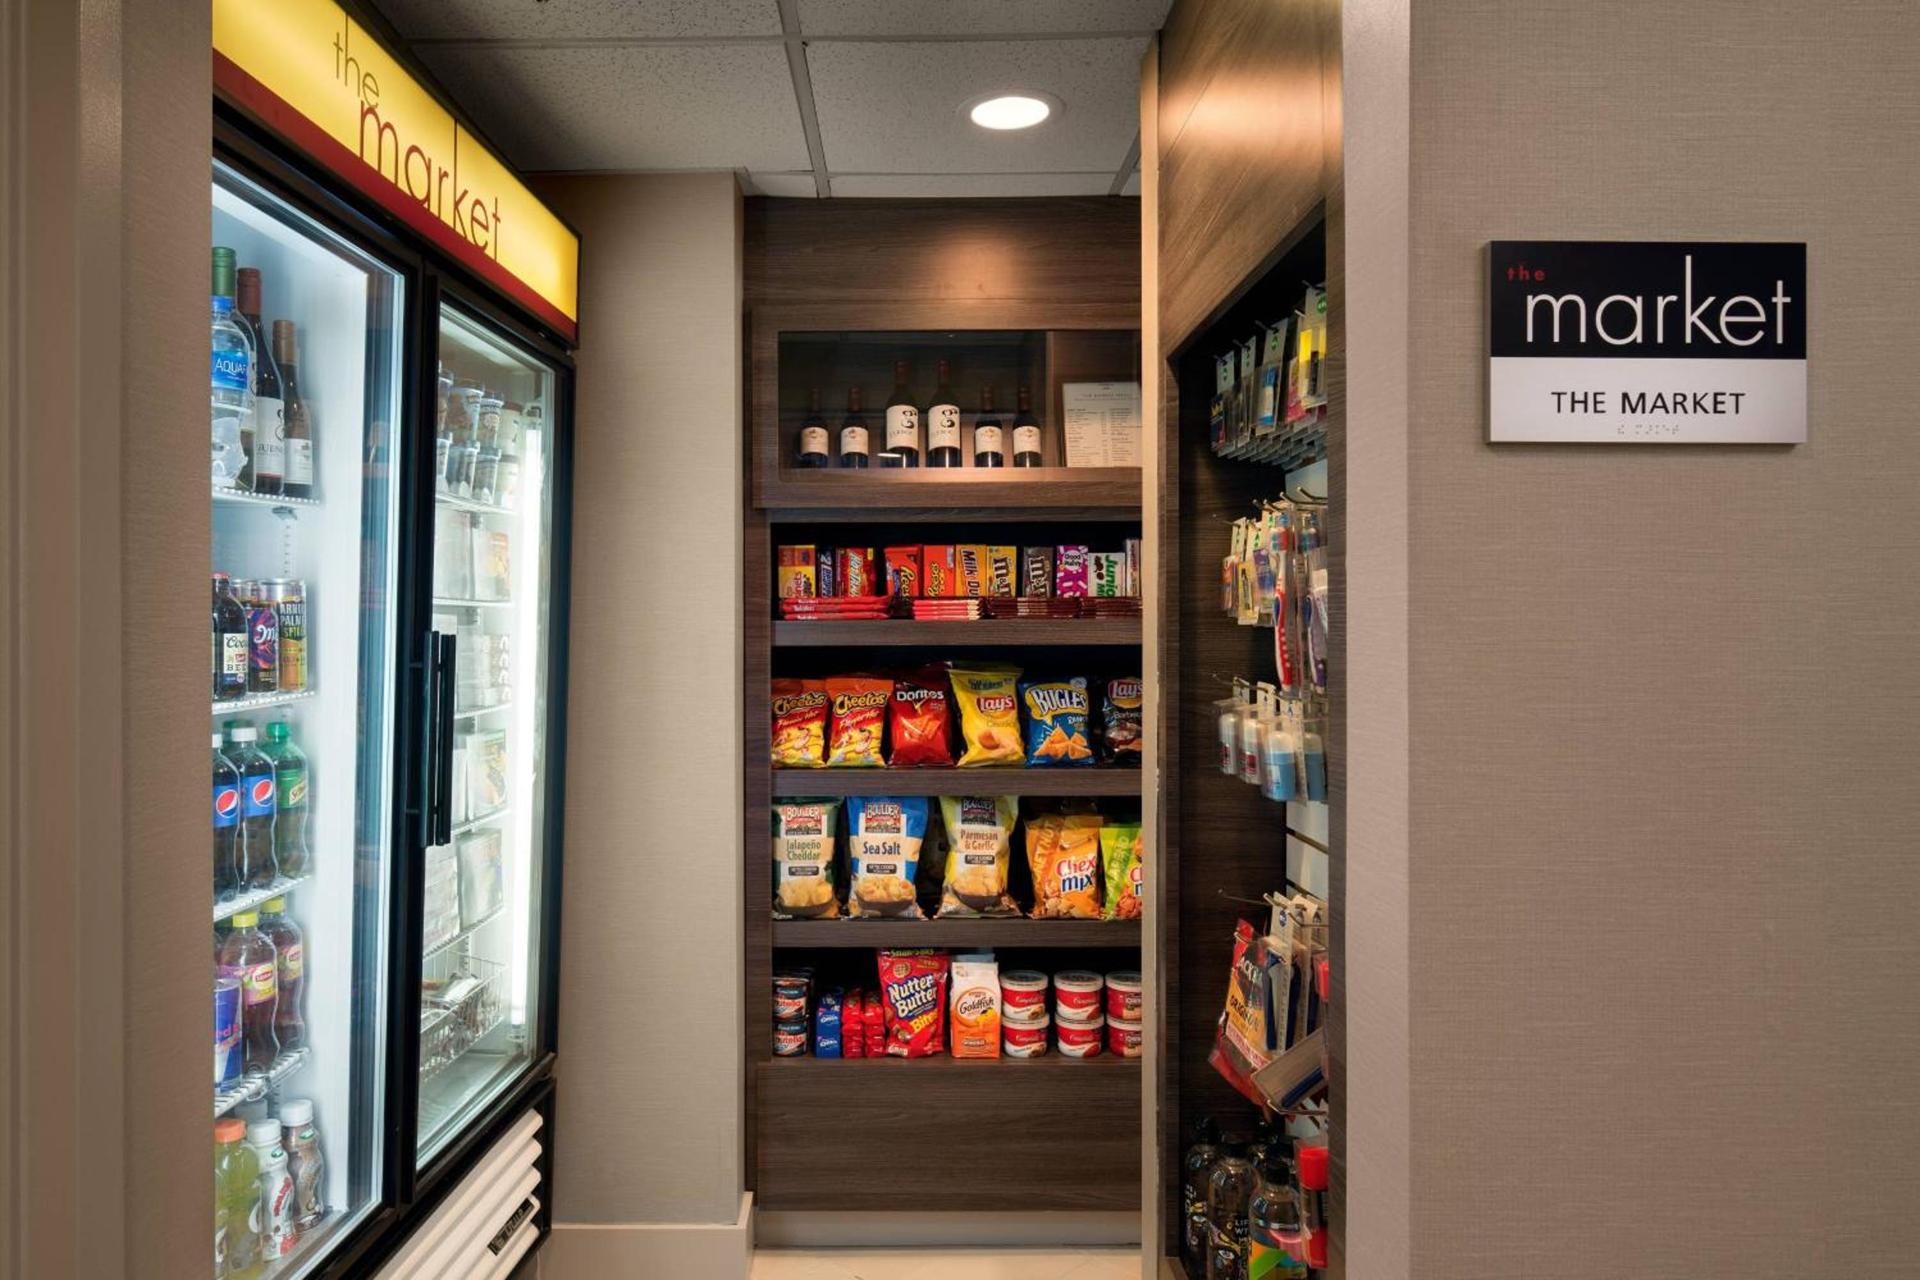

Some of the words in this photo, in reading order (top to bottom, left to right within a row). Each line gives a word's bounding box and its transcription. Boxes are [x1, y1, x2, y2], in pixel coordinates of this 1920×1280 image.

[333, 14, 380, 109] the
[360, 100, 501, 262] market
[1507, 265, 1546, 281] the
[1526, 255, 1792, 346] market
[1551, 391, 1607, 414] THE
[1621, 391, 1747, 415] MARKET
[834, 693, 887, 716] Cheetos
[896, 689, 944, 701] Doritos
[979, 696, 1013, 712] Lay's
[1031, 687, 1087, 715] BUGLES
[960, 828, 998, 841] Parmesan
[863, 842, 881, 855] Sea
[882, 842, 901, 856] Salt
[1057, 855, 1098, 877] Chex
[888, 974, 934, 1003] Nutter
[896, 986, 938, 1018] Butter
[960, 996, 995, 1014] Goldfish
